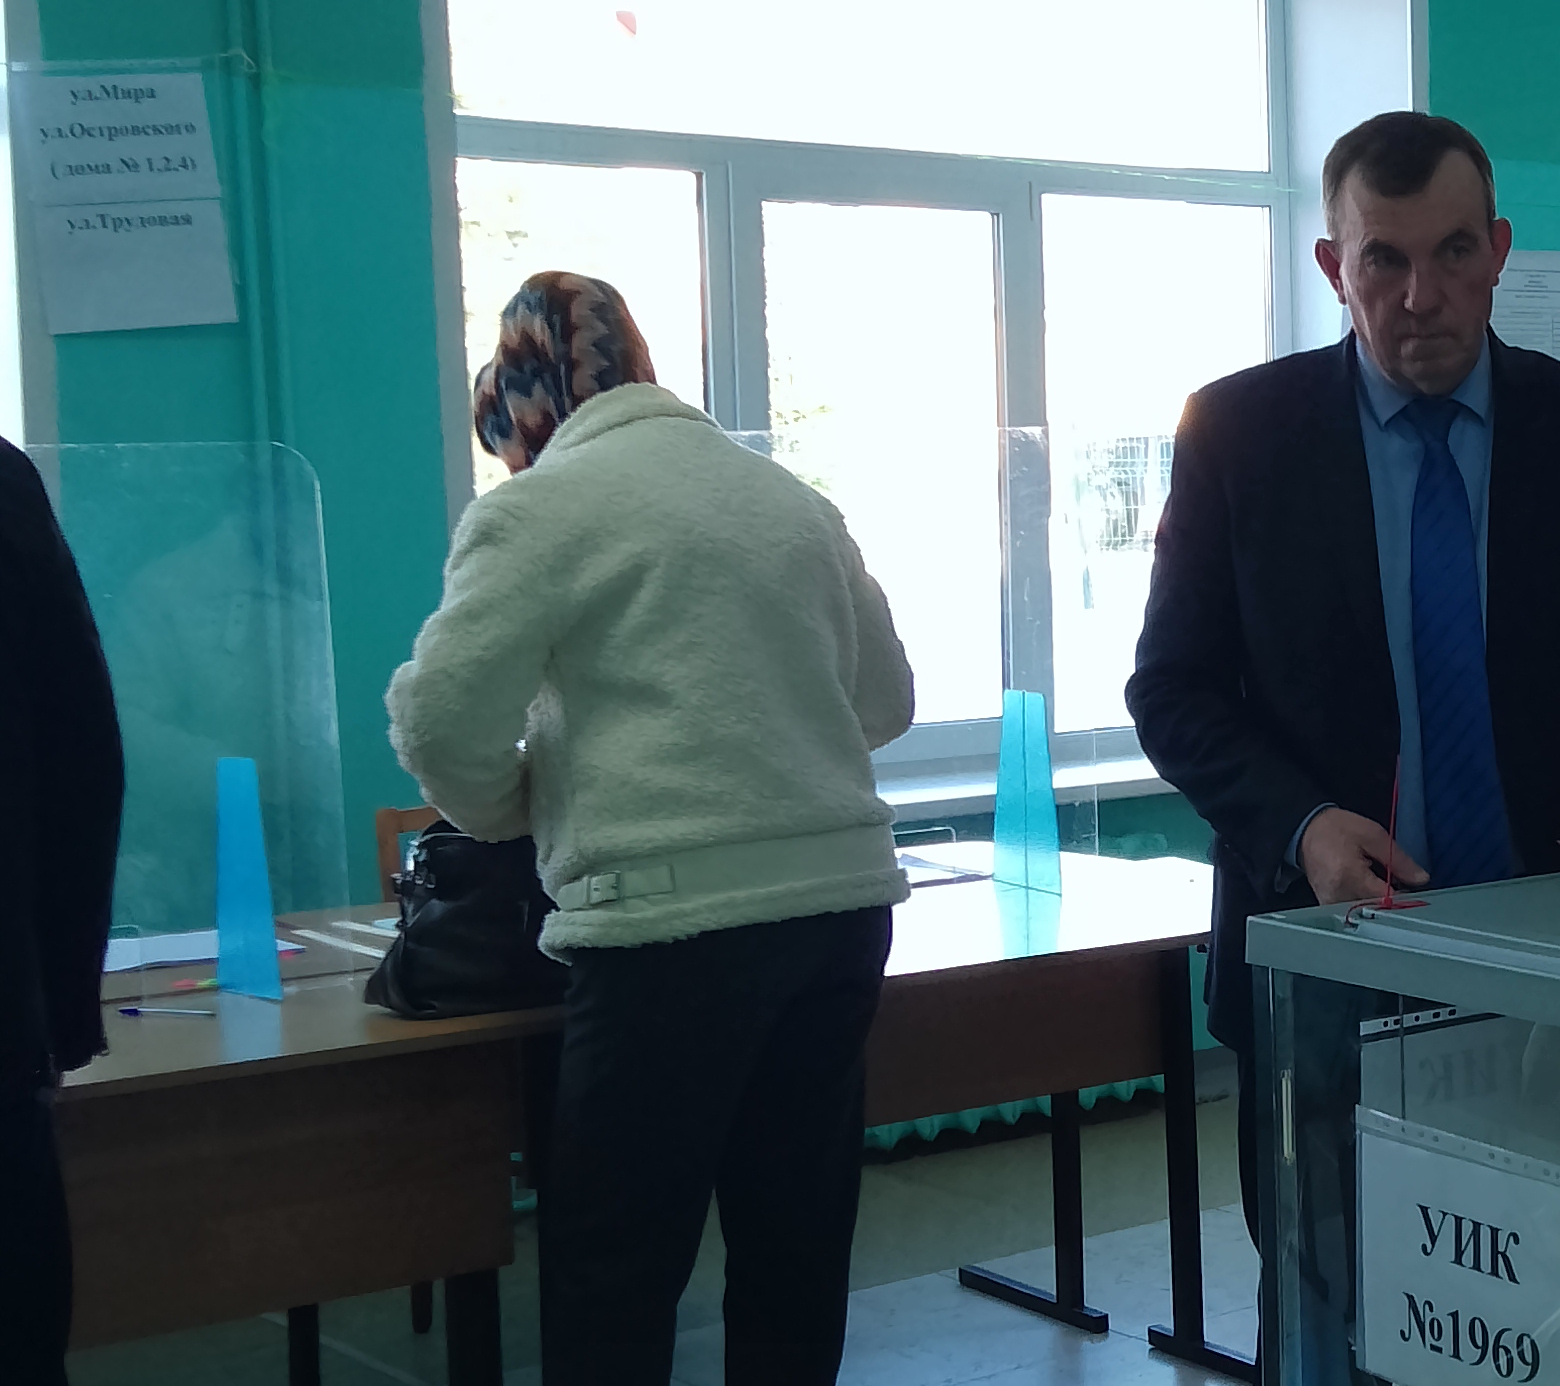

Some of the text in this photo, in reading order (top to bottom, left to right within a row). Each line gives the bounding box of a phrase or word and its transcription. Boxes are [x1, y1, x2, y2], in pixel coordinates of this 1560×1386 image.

[69, 84, 157, 106] ул.Мира
[39, 121, 197, 145] ул.Островского
[1416, 1203, 1520, 1285] УИК
[1400, 1291, 1540, 1383] №1969
